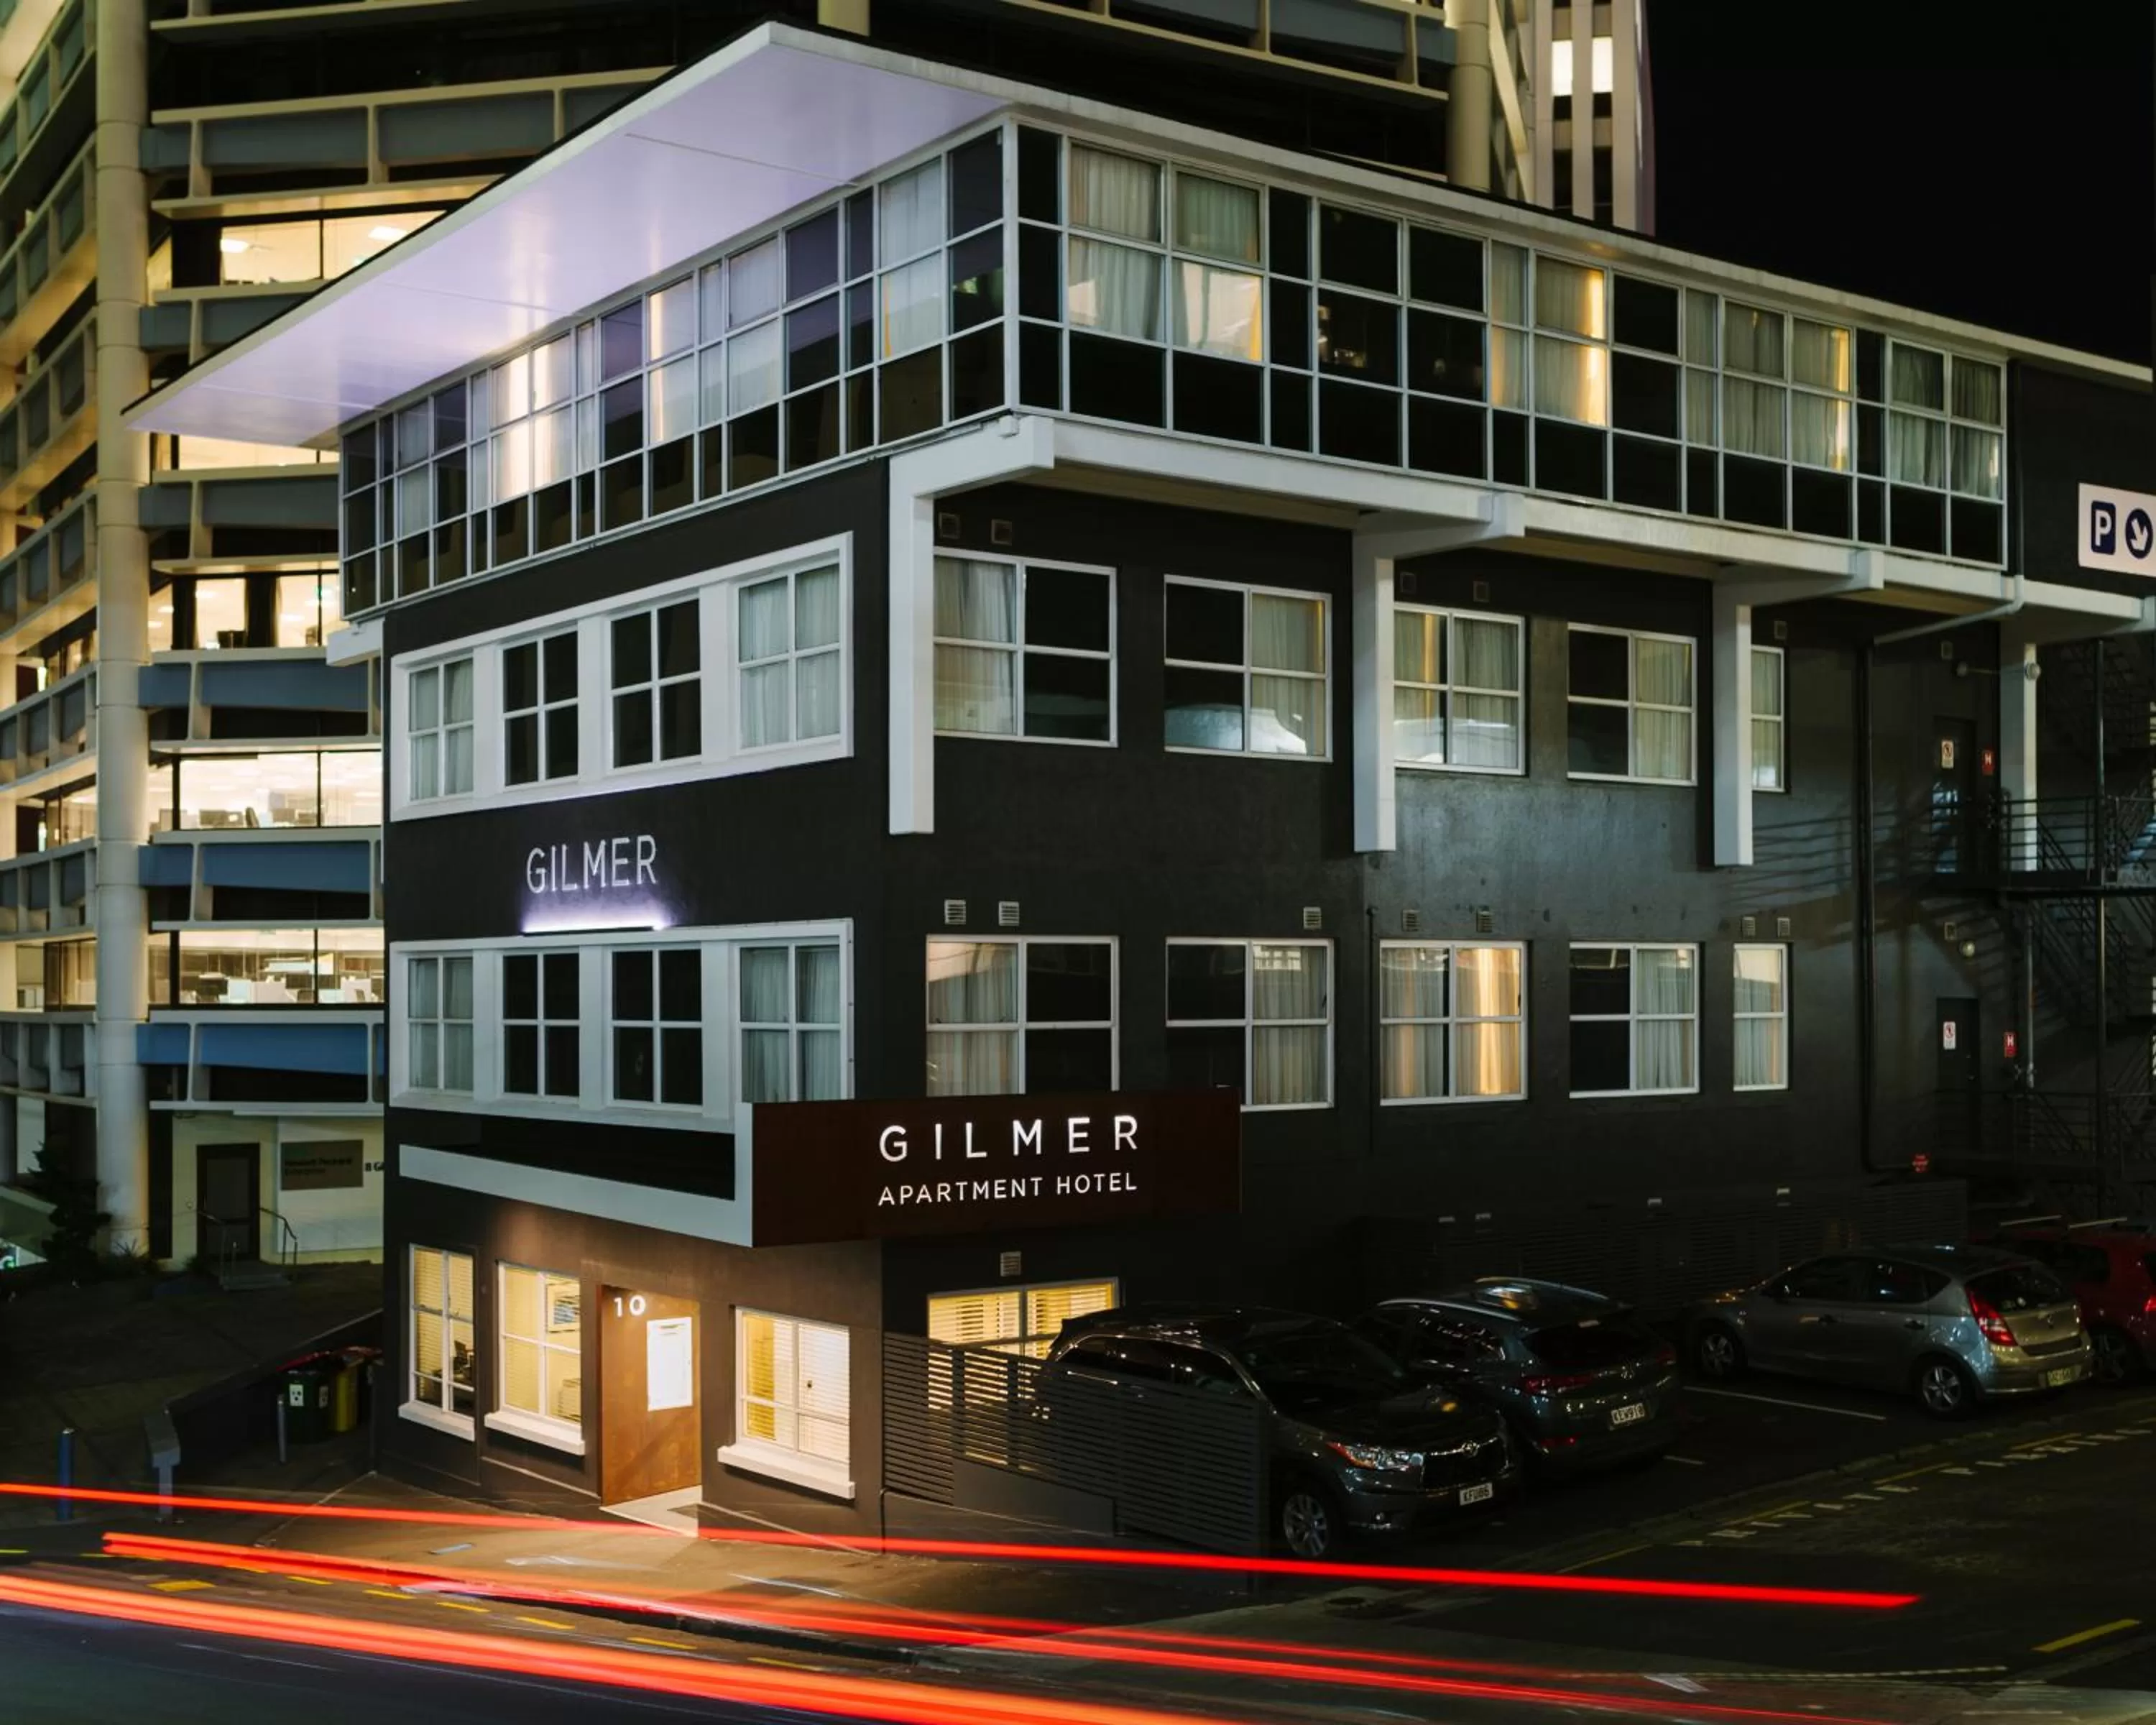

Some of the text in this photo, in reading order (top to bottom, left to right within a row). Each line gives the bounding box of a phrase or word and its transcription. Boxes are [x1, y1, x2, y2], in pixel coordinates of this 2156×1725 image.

[2094, 509, 2112, 547] P
[525, 834, 658, 893] GILMER
[879, 1115, 1139, 1163] GILMER
[877, 1172, 1138, 1208] APARTMENT HOTEL
[613, 1294, 645, 1317] 10
